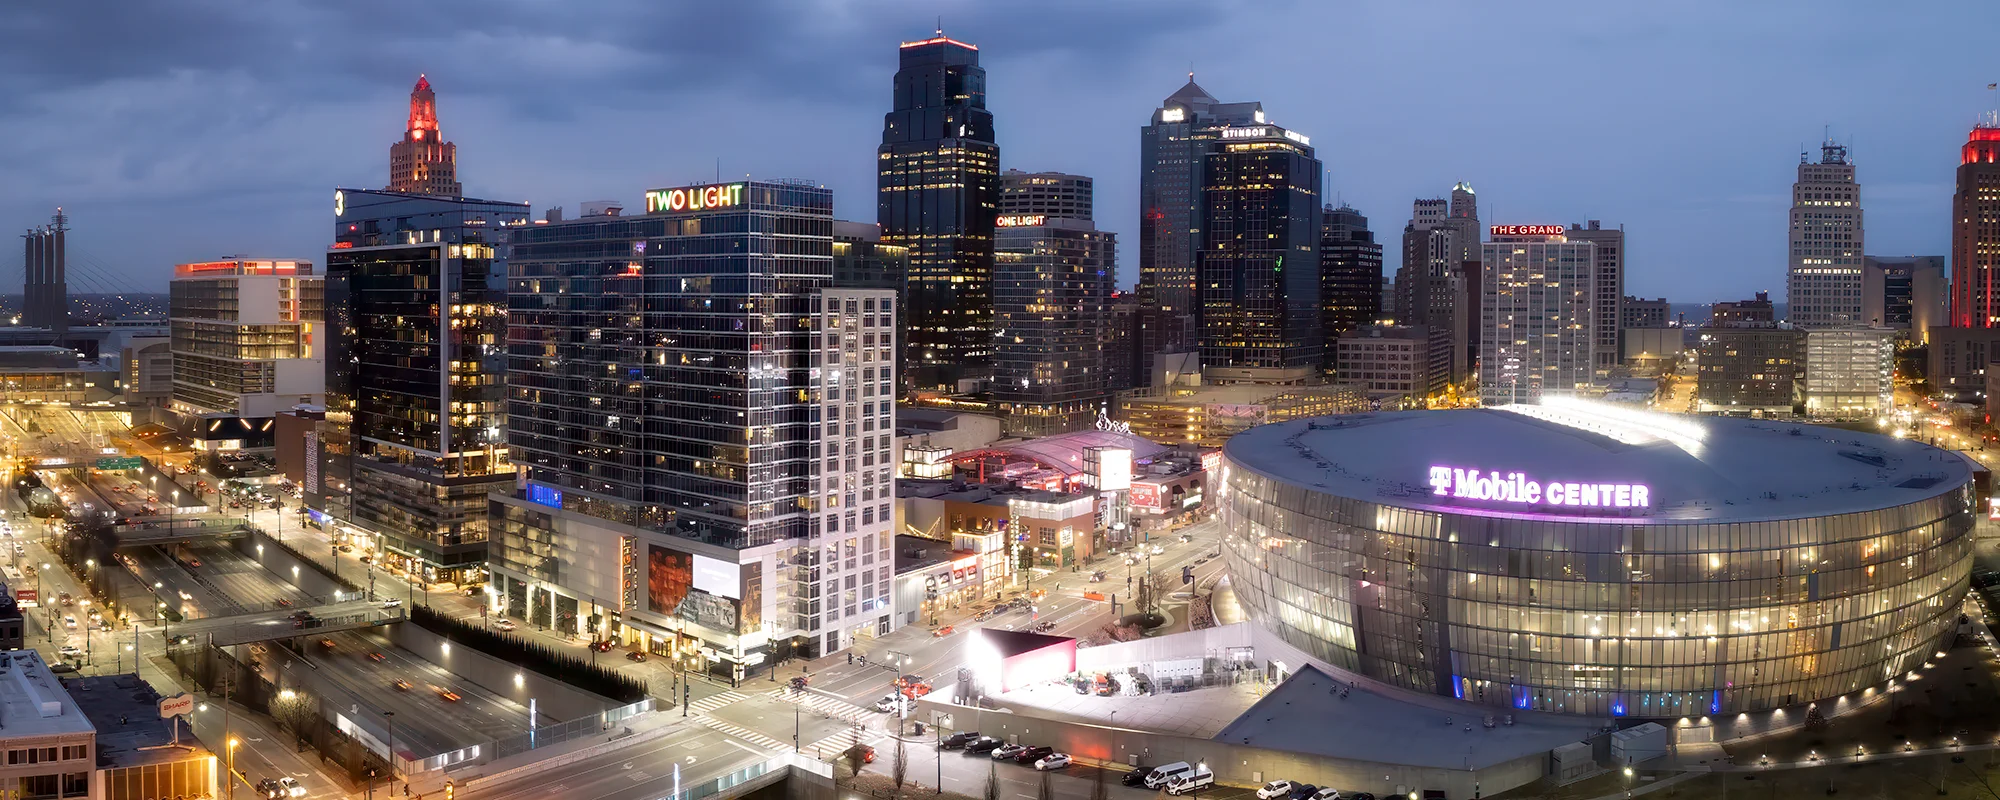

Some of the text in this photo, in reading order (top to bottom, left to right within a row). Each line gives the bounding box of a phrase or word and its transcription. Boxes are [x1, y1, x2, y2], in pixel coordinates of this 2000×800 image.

[1222, 127, 1266, 138] STINSON
[335, 190, 344, 216] 3
[646, 184, 743, 212] TWO LIGHT
[996, 215, 1045, 227] ONE LIGHT
[1491, 225, 1564, 235] THE GRAND
[1546, 482, 1649, 507] CENTER
[623, 538, 632, 609] TWO LIGHT
[163, 699, 191, 711] SHARP
